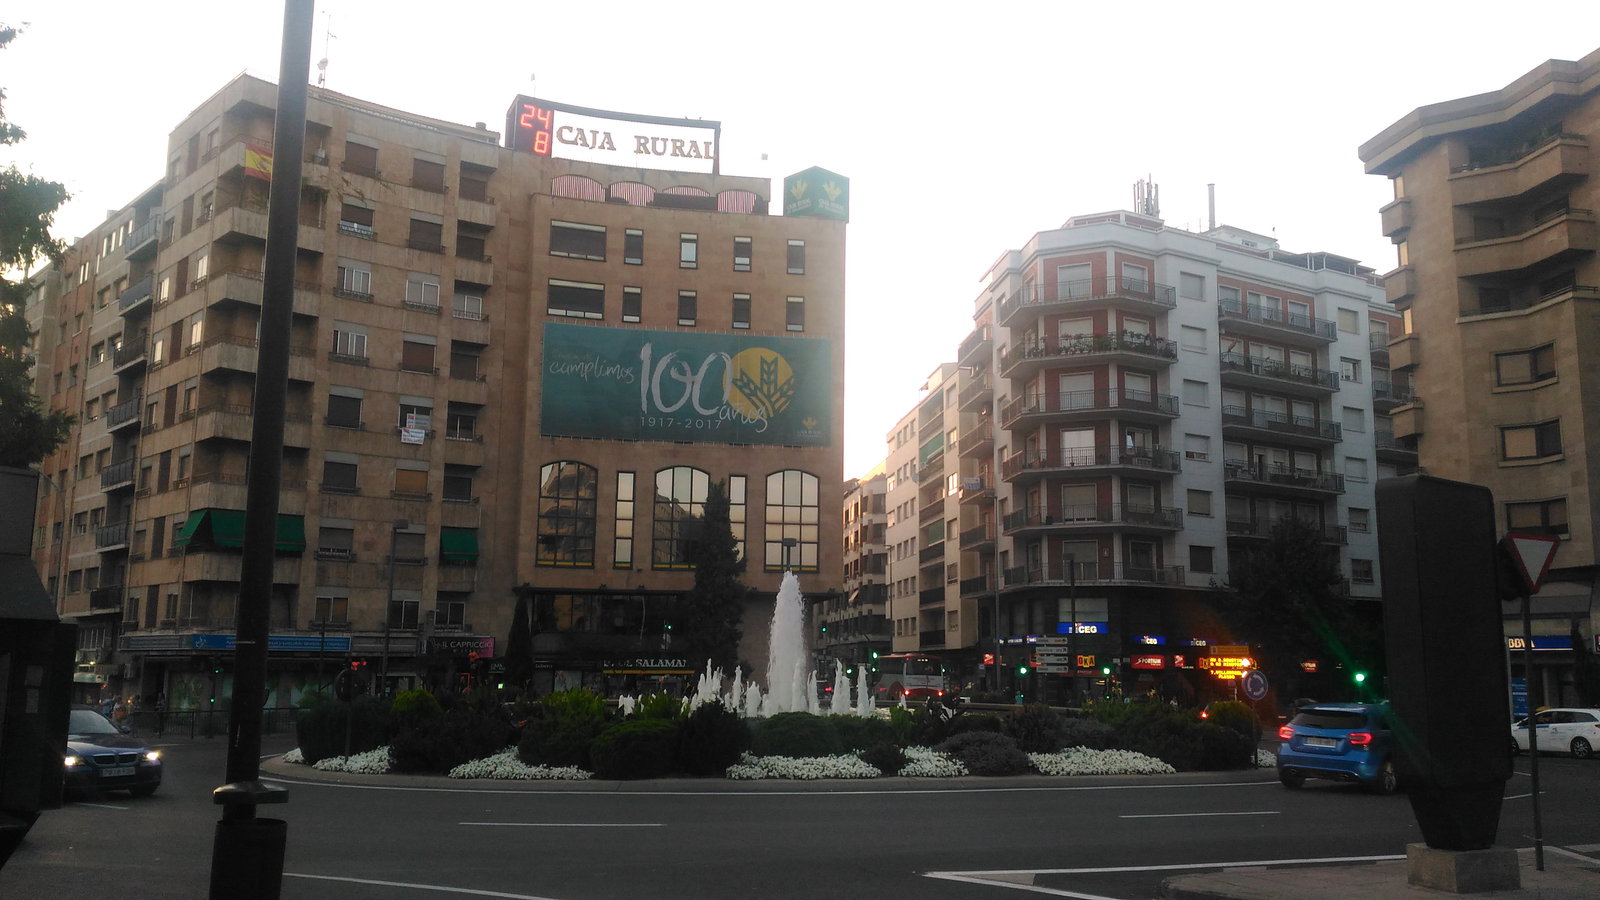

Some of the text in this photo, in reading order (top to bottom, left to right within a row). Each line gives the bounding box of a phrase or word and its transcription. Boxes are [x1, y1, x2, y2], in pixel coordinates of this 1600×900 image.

[520, 103, 551, 130] 24
[534, 130, 549, 155] 8
[556, 125, 716, 159] CAJA RURAL
[549, 342, 768, 433] cumplimos 100 años
[640, 416, 723, 430] 1917-2017
[449, 640, 494, 649] CAPRICCIO
